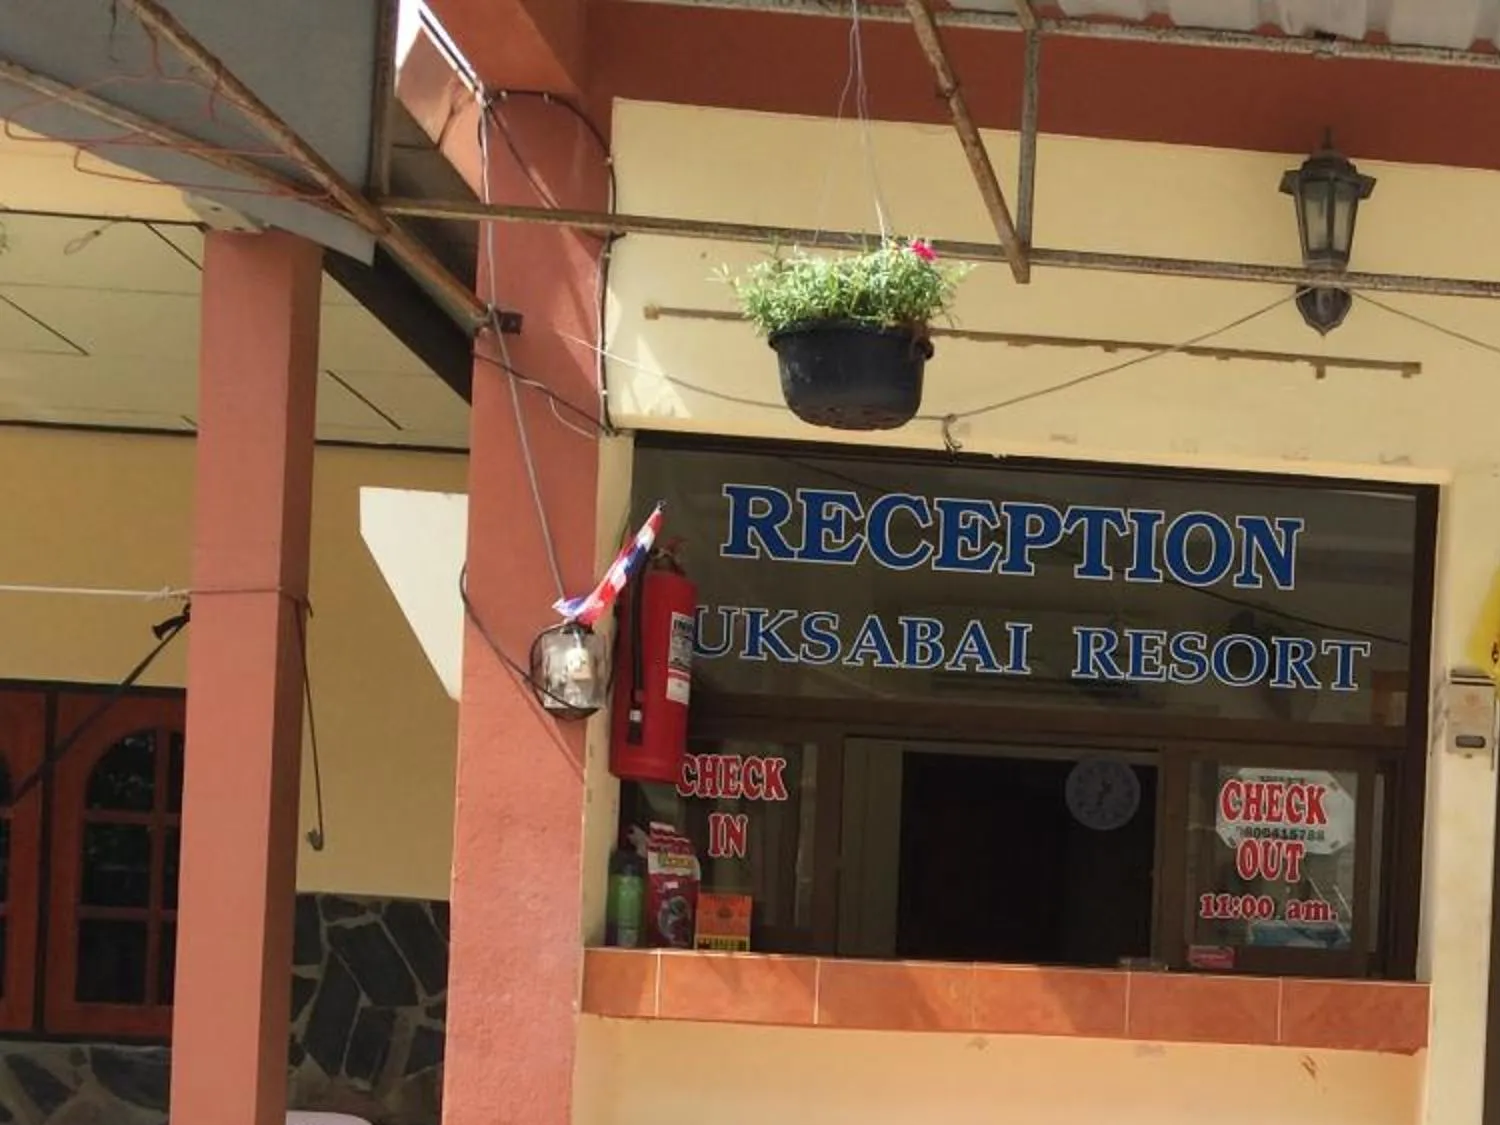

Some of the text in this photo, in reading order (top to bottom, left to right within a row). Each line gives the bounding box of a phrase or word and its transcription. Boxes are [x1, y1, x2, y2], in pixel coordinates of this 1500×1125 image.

[720, 483, 1304, 591] RECEPTION
[690, 604, 1371, 692] UKSABAI RESORT
[676, 754, 788, 801] CHECK
[1219, 778, 1328, 826] CHECK
[708, 813, 748, 857] IN
[1236, 838, 1305, 883] OUT
[1200, 892, 1339, 922] 11:00 am.
